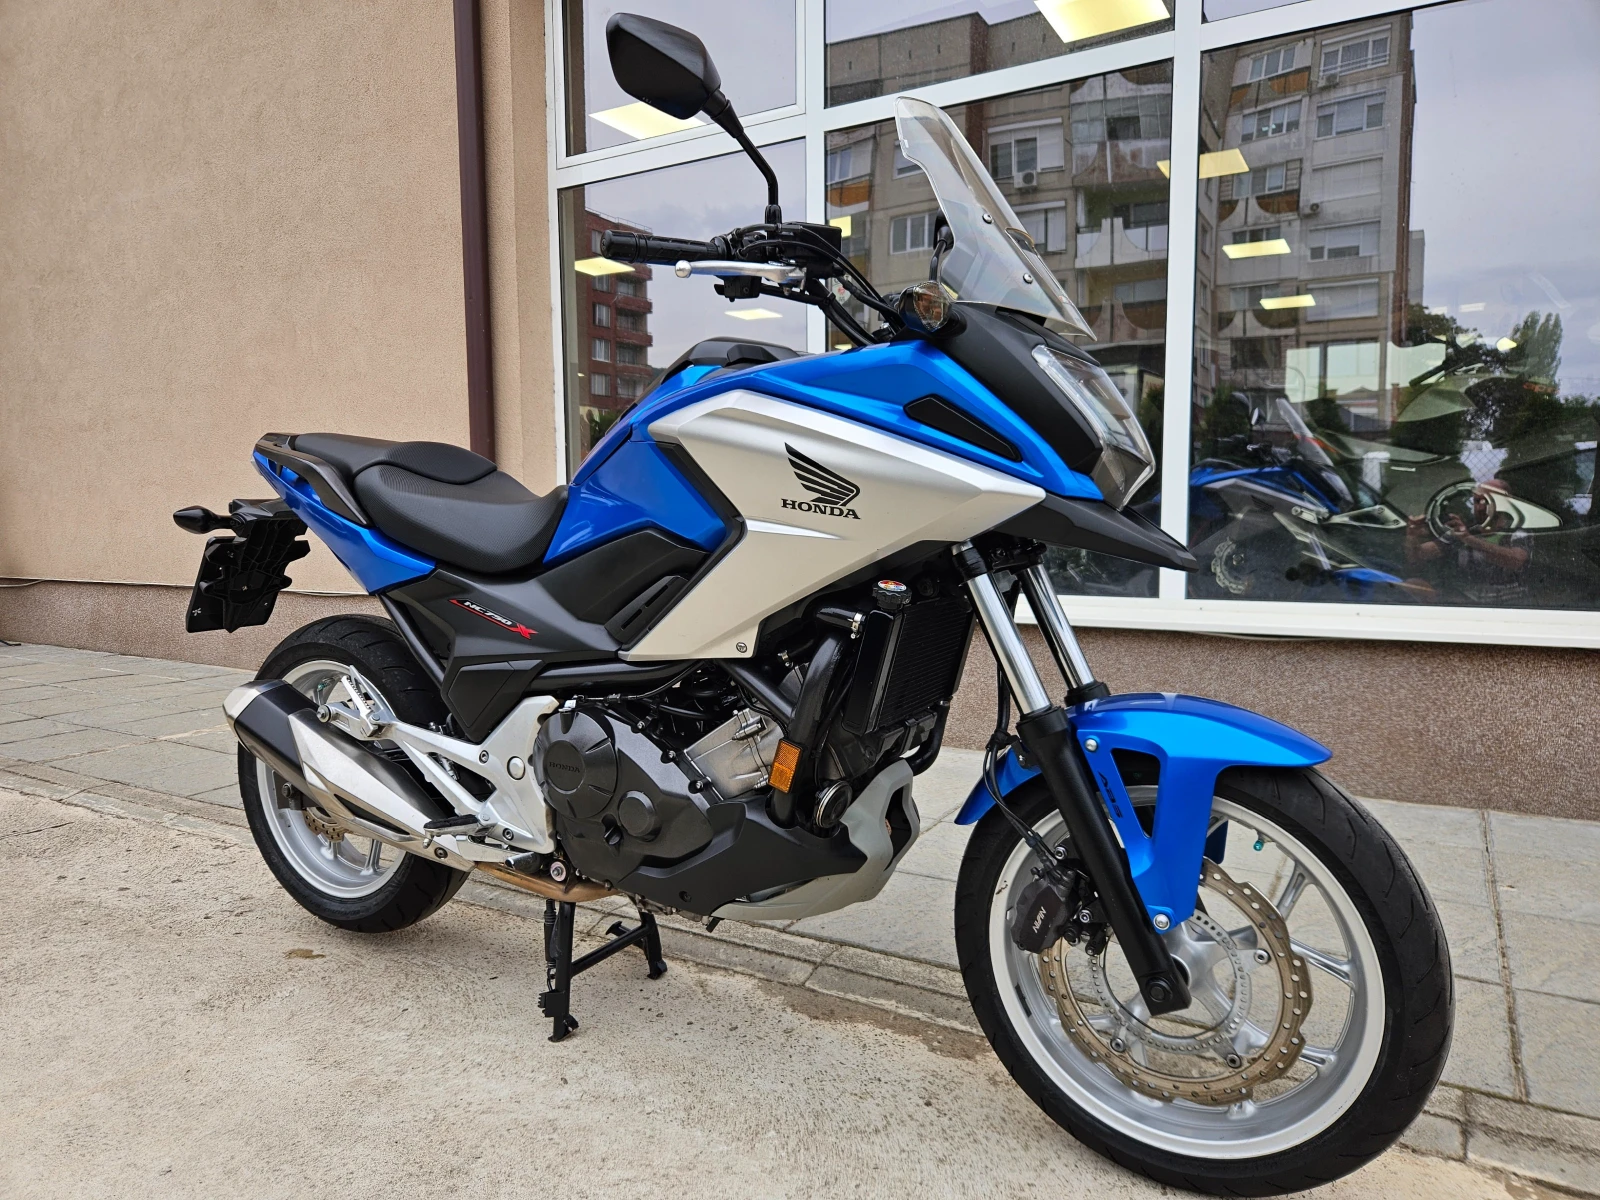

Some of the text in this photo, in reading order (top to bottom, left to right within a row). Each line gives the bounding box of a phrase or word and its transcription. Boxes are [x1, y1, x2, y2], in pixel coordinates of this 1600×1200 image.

[781, 498, 861, 520] HONDA
[549, 761, 580, 773] HONDA
[1098, 771, 1123, 819] ABS
